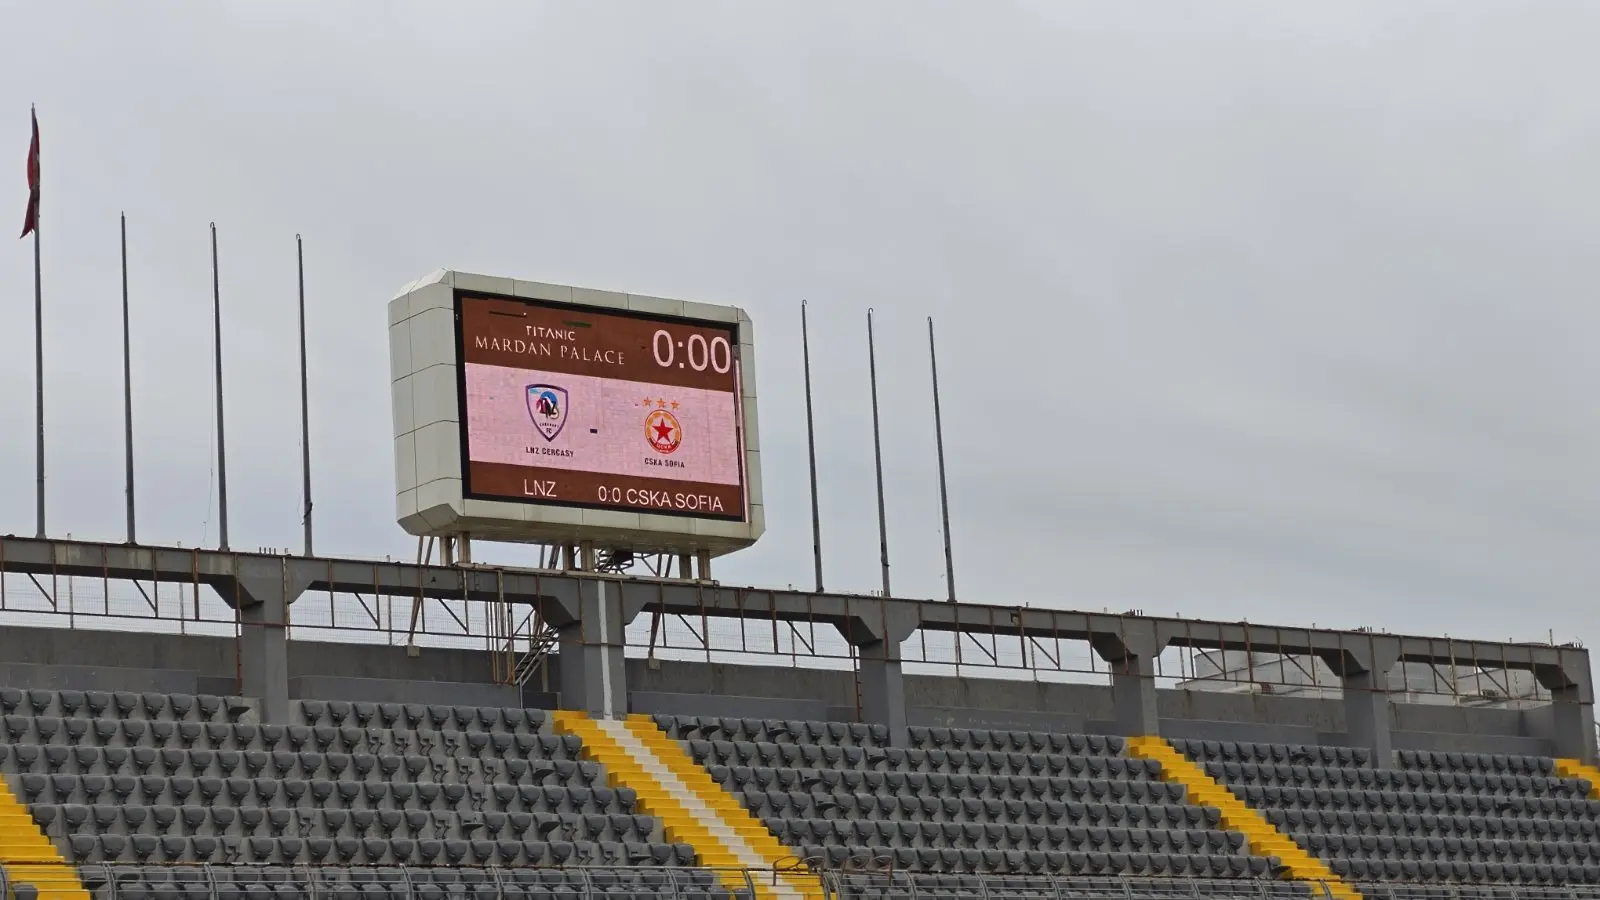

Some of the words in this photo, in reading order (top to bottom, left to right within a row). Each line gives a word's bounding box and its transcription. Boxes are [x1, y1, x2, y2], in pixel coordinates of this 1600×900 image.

[525, 325, 576, 342] TITANIC
[475, 336, 552, 357] MARDAN
[560, 345, 626, 365] PALACE
[652, 329, 732, 374] 0:00
[525, 446, 540, 455] LNZ
[644, 457, 663, 467] CSKA
[664, 459, 685, 468] SOFIA
[523, 479, 558, 498] LNZ
[598, 485, 621, 503] 0:0
[626, 488, 673, 508] CSKA
[675, 492, 724, 512] SOFIA
